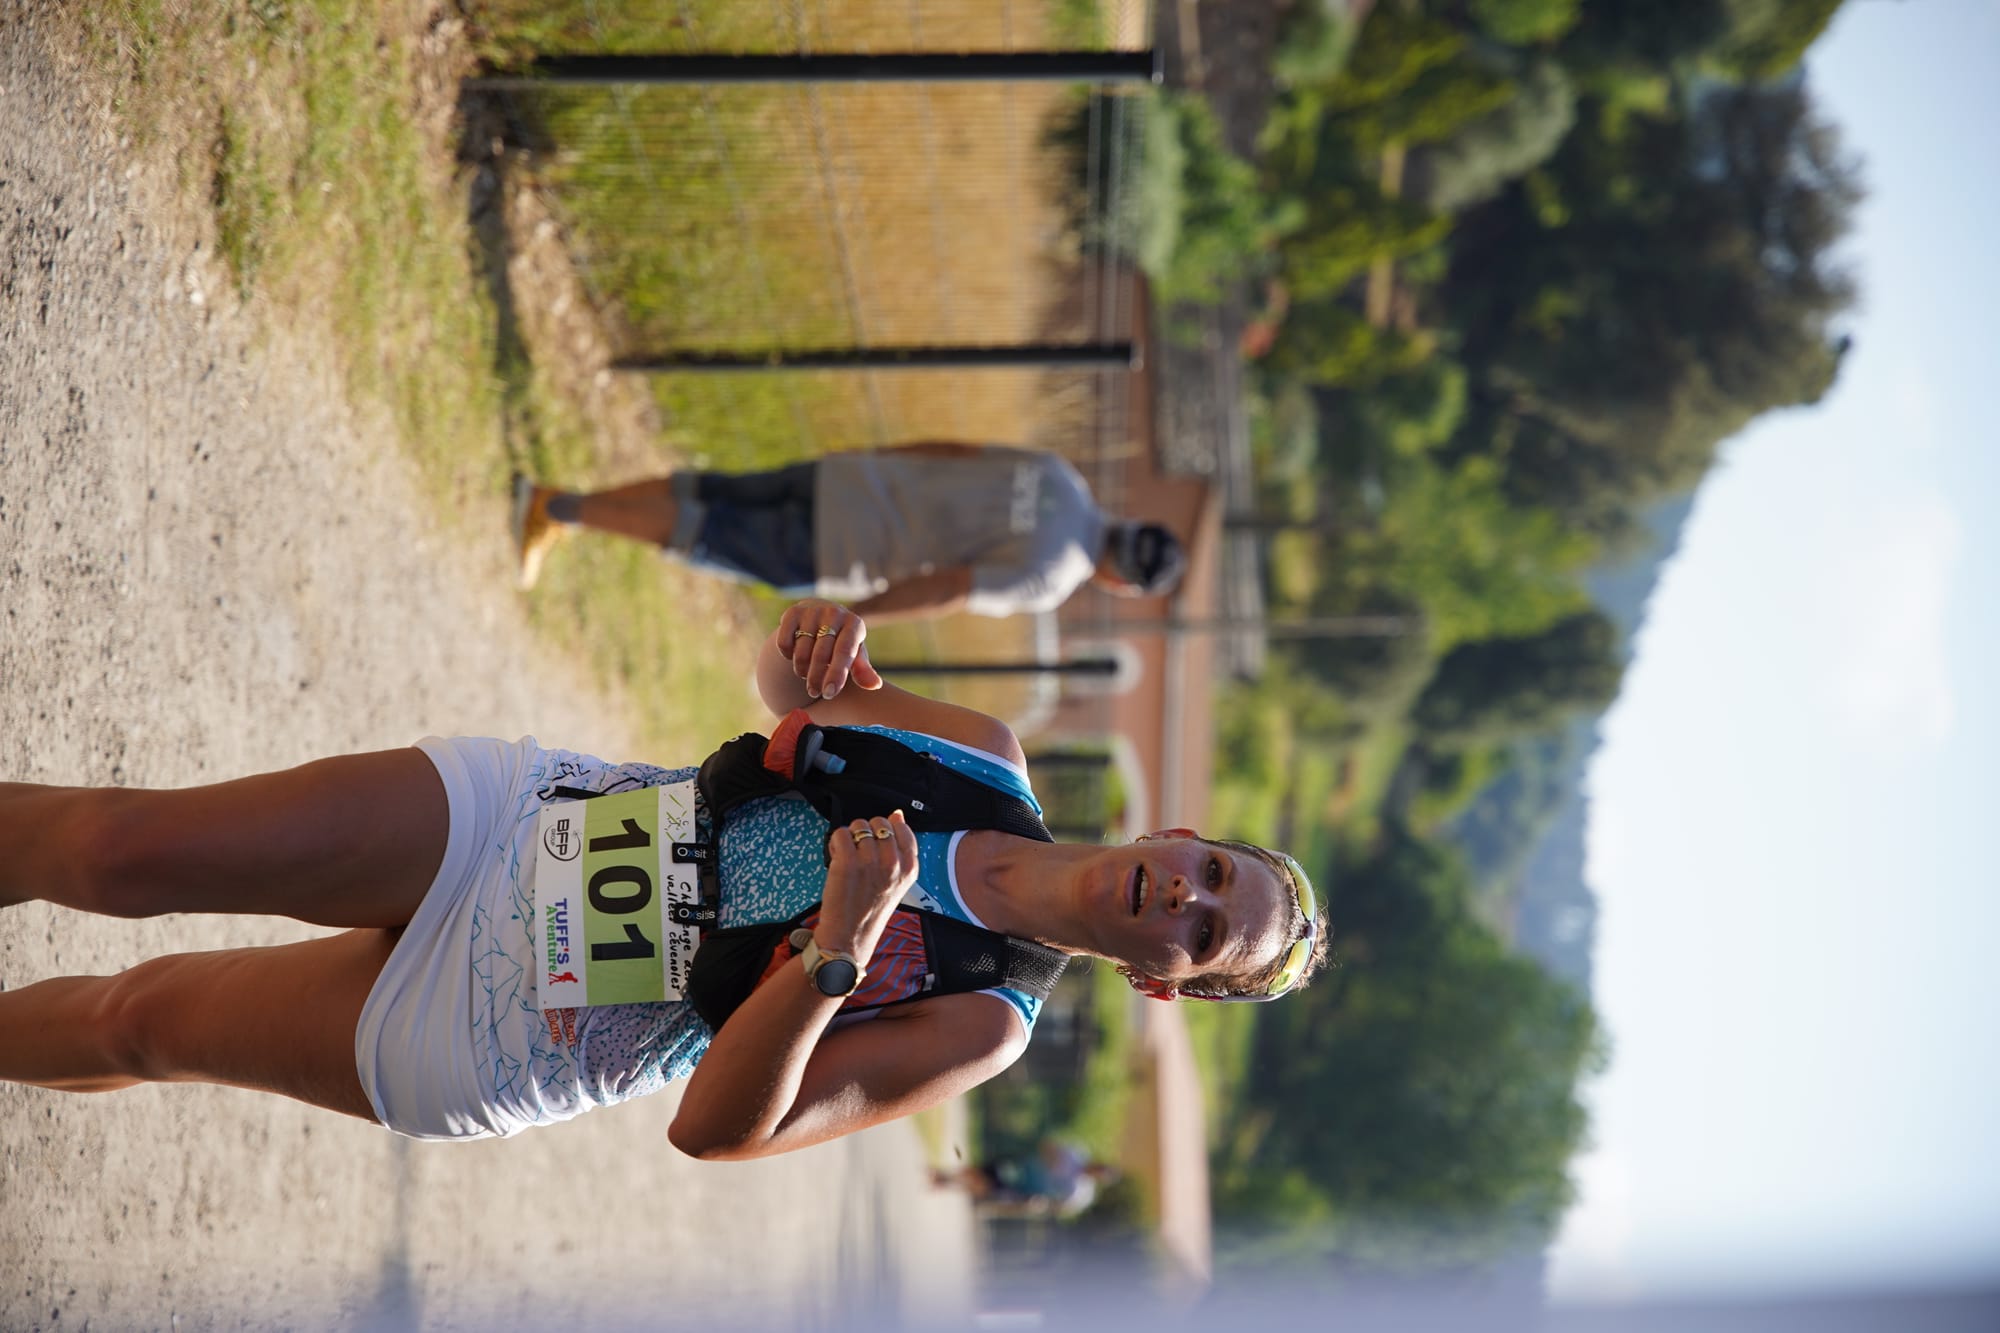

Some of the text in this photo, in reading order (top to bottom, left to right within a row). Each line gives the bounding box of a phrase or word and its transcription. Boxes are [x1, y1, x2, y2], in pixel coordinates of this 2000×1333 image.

[556, 818, 570, 855] BFP
[588, 818, 655, 961] 101
[546, 904, 559, 972] Aventure
[555, 898, 570, 965] TUFF'S
[561, 1008, 576, 1046] ADEAUX
